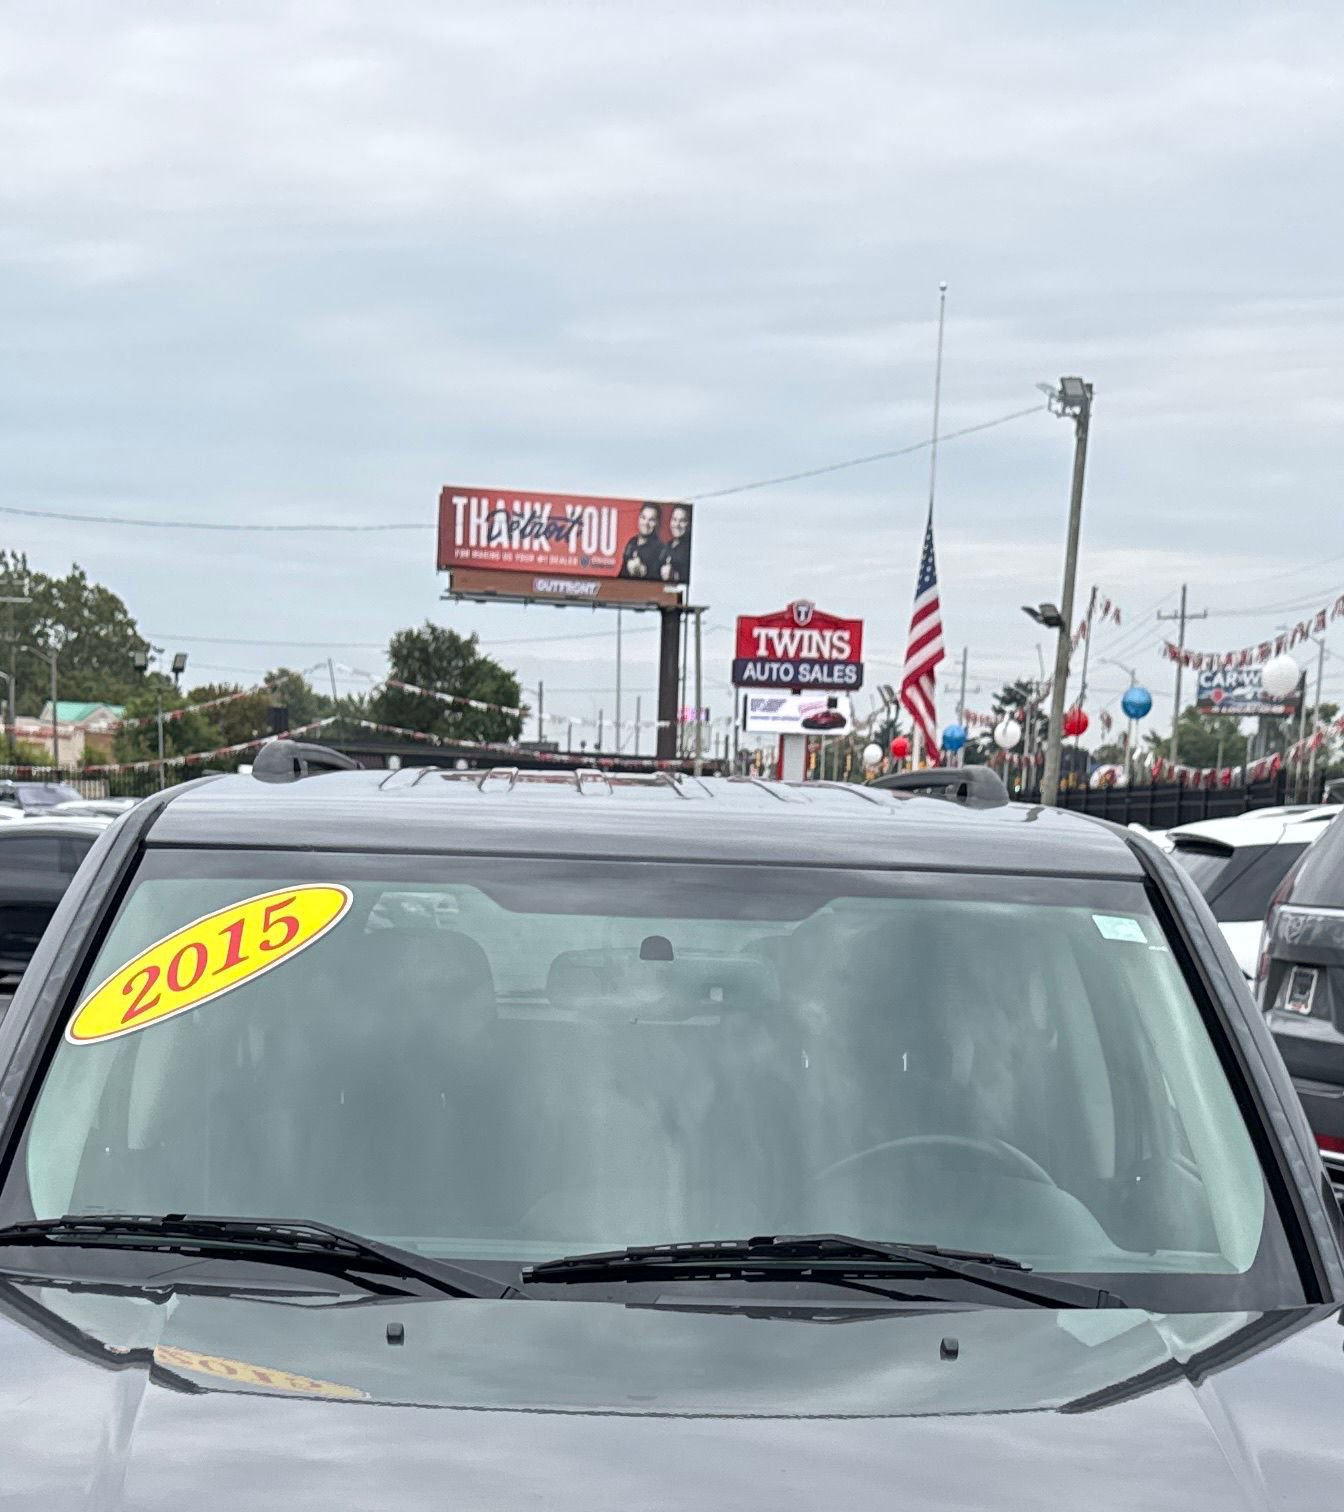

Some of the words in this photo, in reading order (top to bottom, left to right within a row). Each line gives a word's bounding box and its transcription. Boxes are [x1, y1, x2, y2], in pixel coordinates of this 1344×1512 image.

[452, 496, 552, 552] THANK
[565, 504, 618, 556] YOU
[752, 627, 852, 660] TWINS
[742, 661, 795, 682] AUTO
[797, 663, 857, 684] SALES
[1200, 671, 1237, 687] CAR
[120, 896, 300, 1024] 2015
